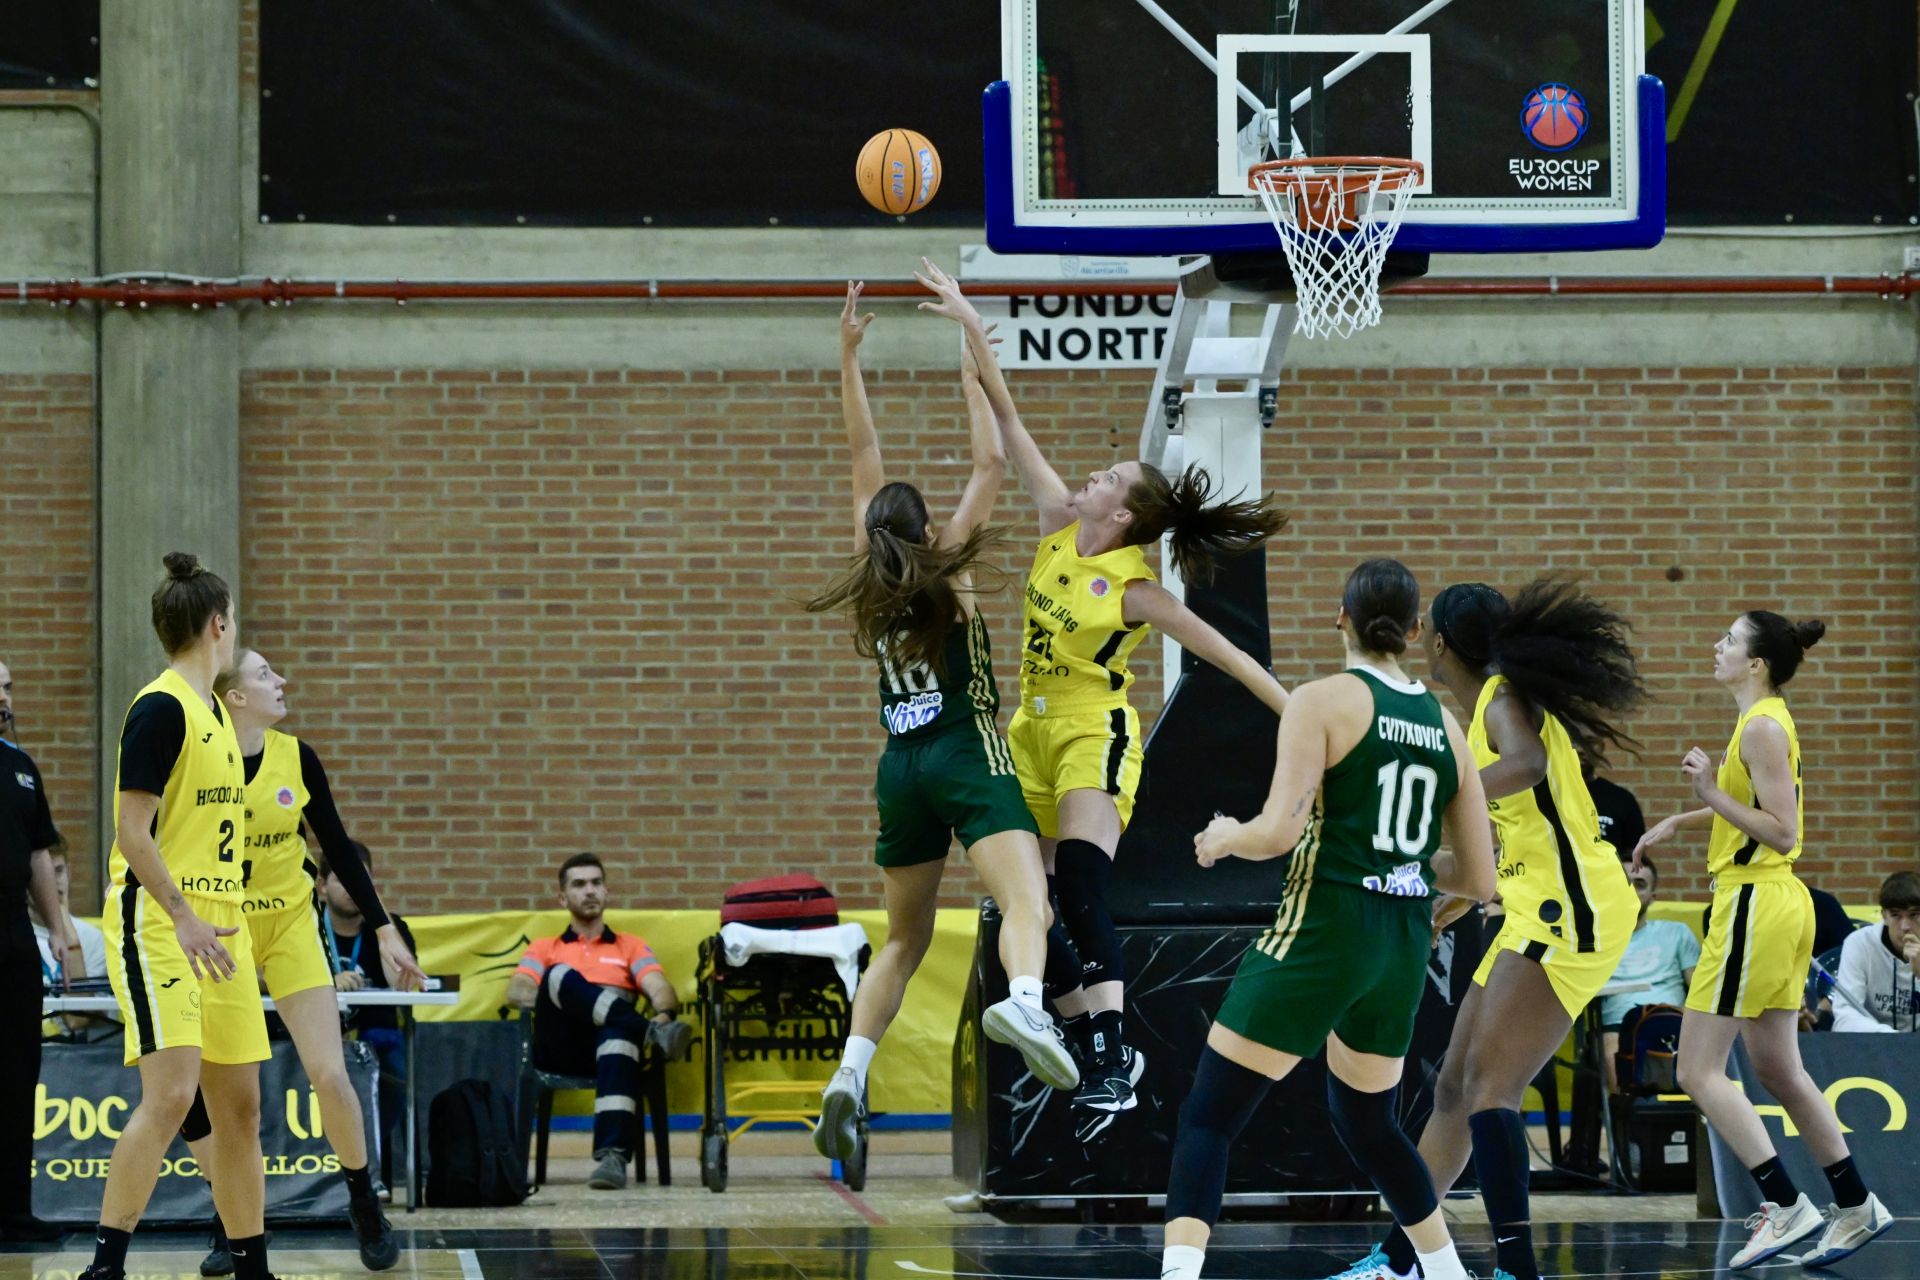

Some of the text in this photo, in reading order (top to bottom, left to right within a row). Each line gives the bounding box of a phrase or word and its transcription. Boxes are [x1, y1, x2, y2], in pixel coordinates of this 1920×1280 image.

[1509, 159, 1600, 175] EUROCUP
[1516, 175, 1592, 190] WOMEN
[910, 693, 940, 707] Juice
[1378, 715, 1446, 752] CVITKOVIC
[1372, 759, 1438, 855] 10
[219, 819, 233, 862] 2
